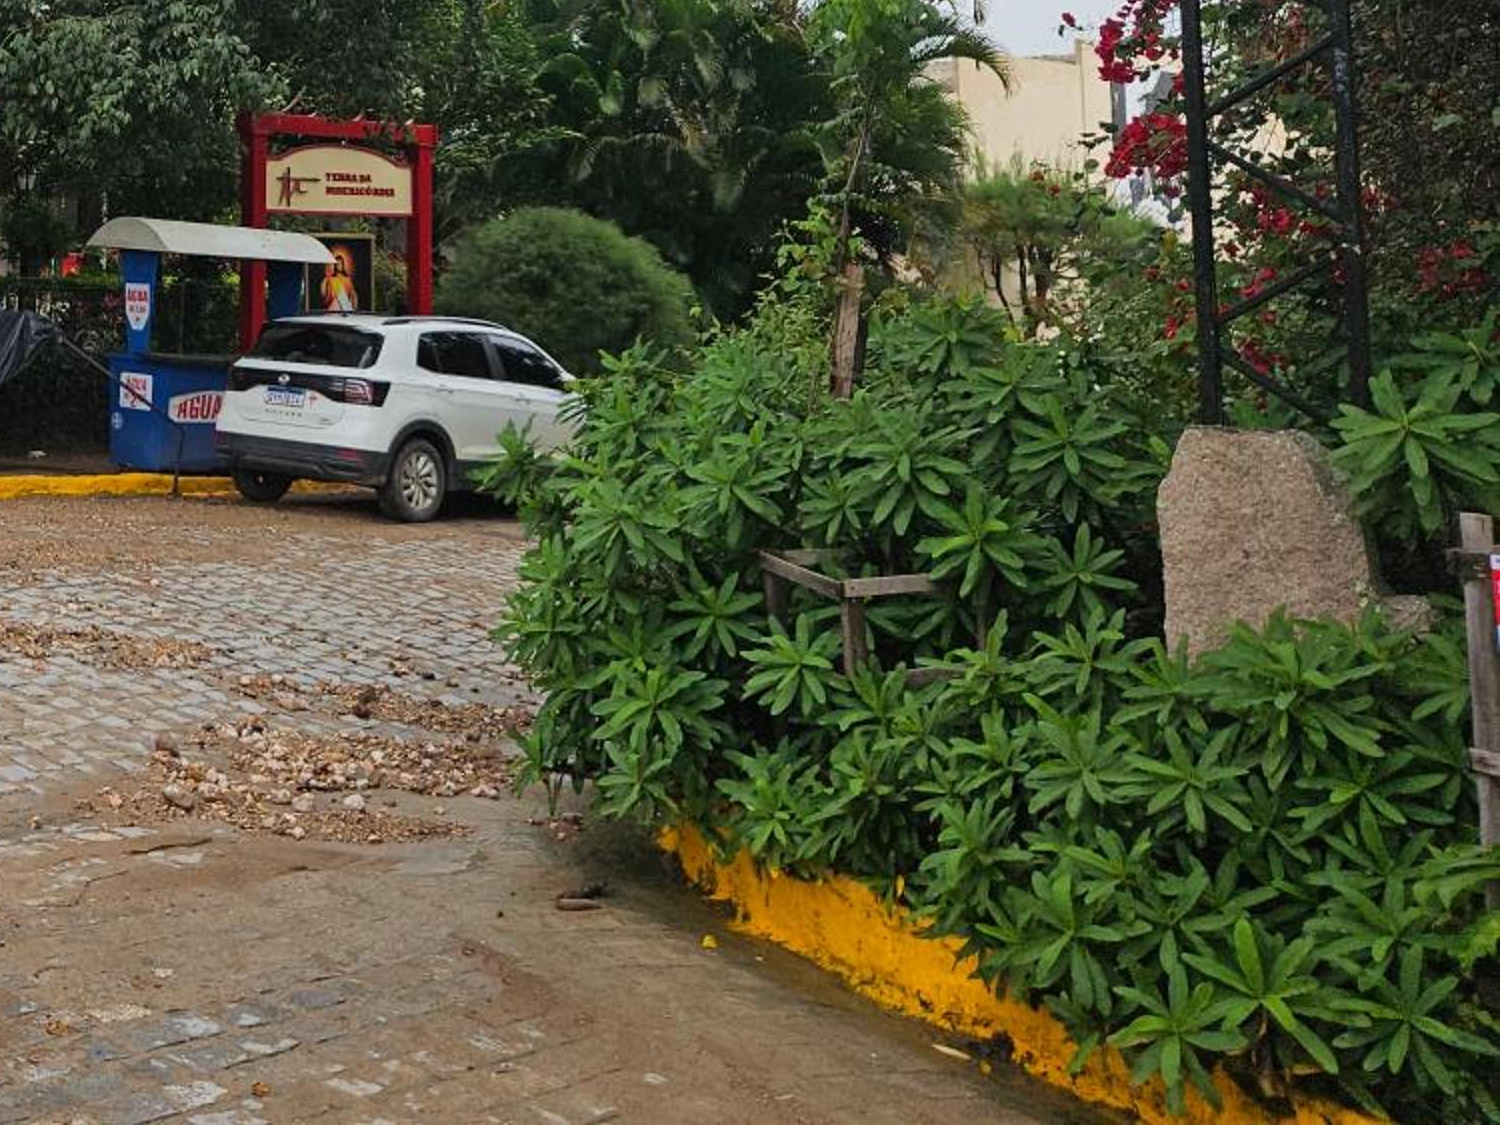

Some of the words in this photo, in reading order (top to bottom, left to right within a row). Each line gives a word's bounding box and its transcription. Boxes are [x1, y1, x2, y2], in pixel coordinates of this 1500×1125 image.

[325, 172, 358, 183] TERRA
[359, 173, 372, 184] DA
[325, 184, 395, 197] MISERICÓRDIA
